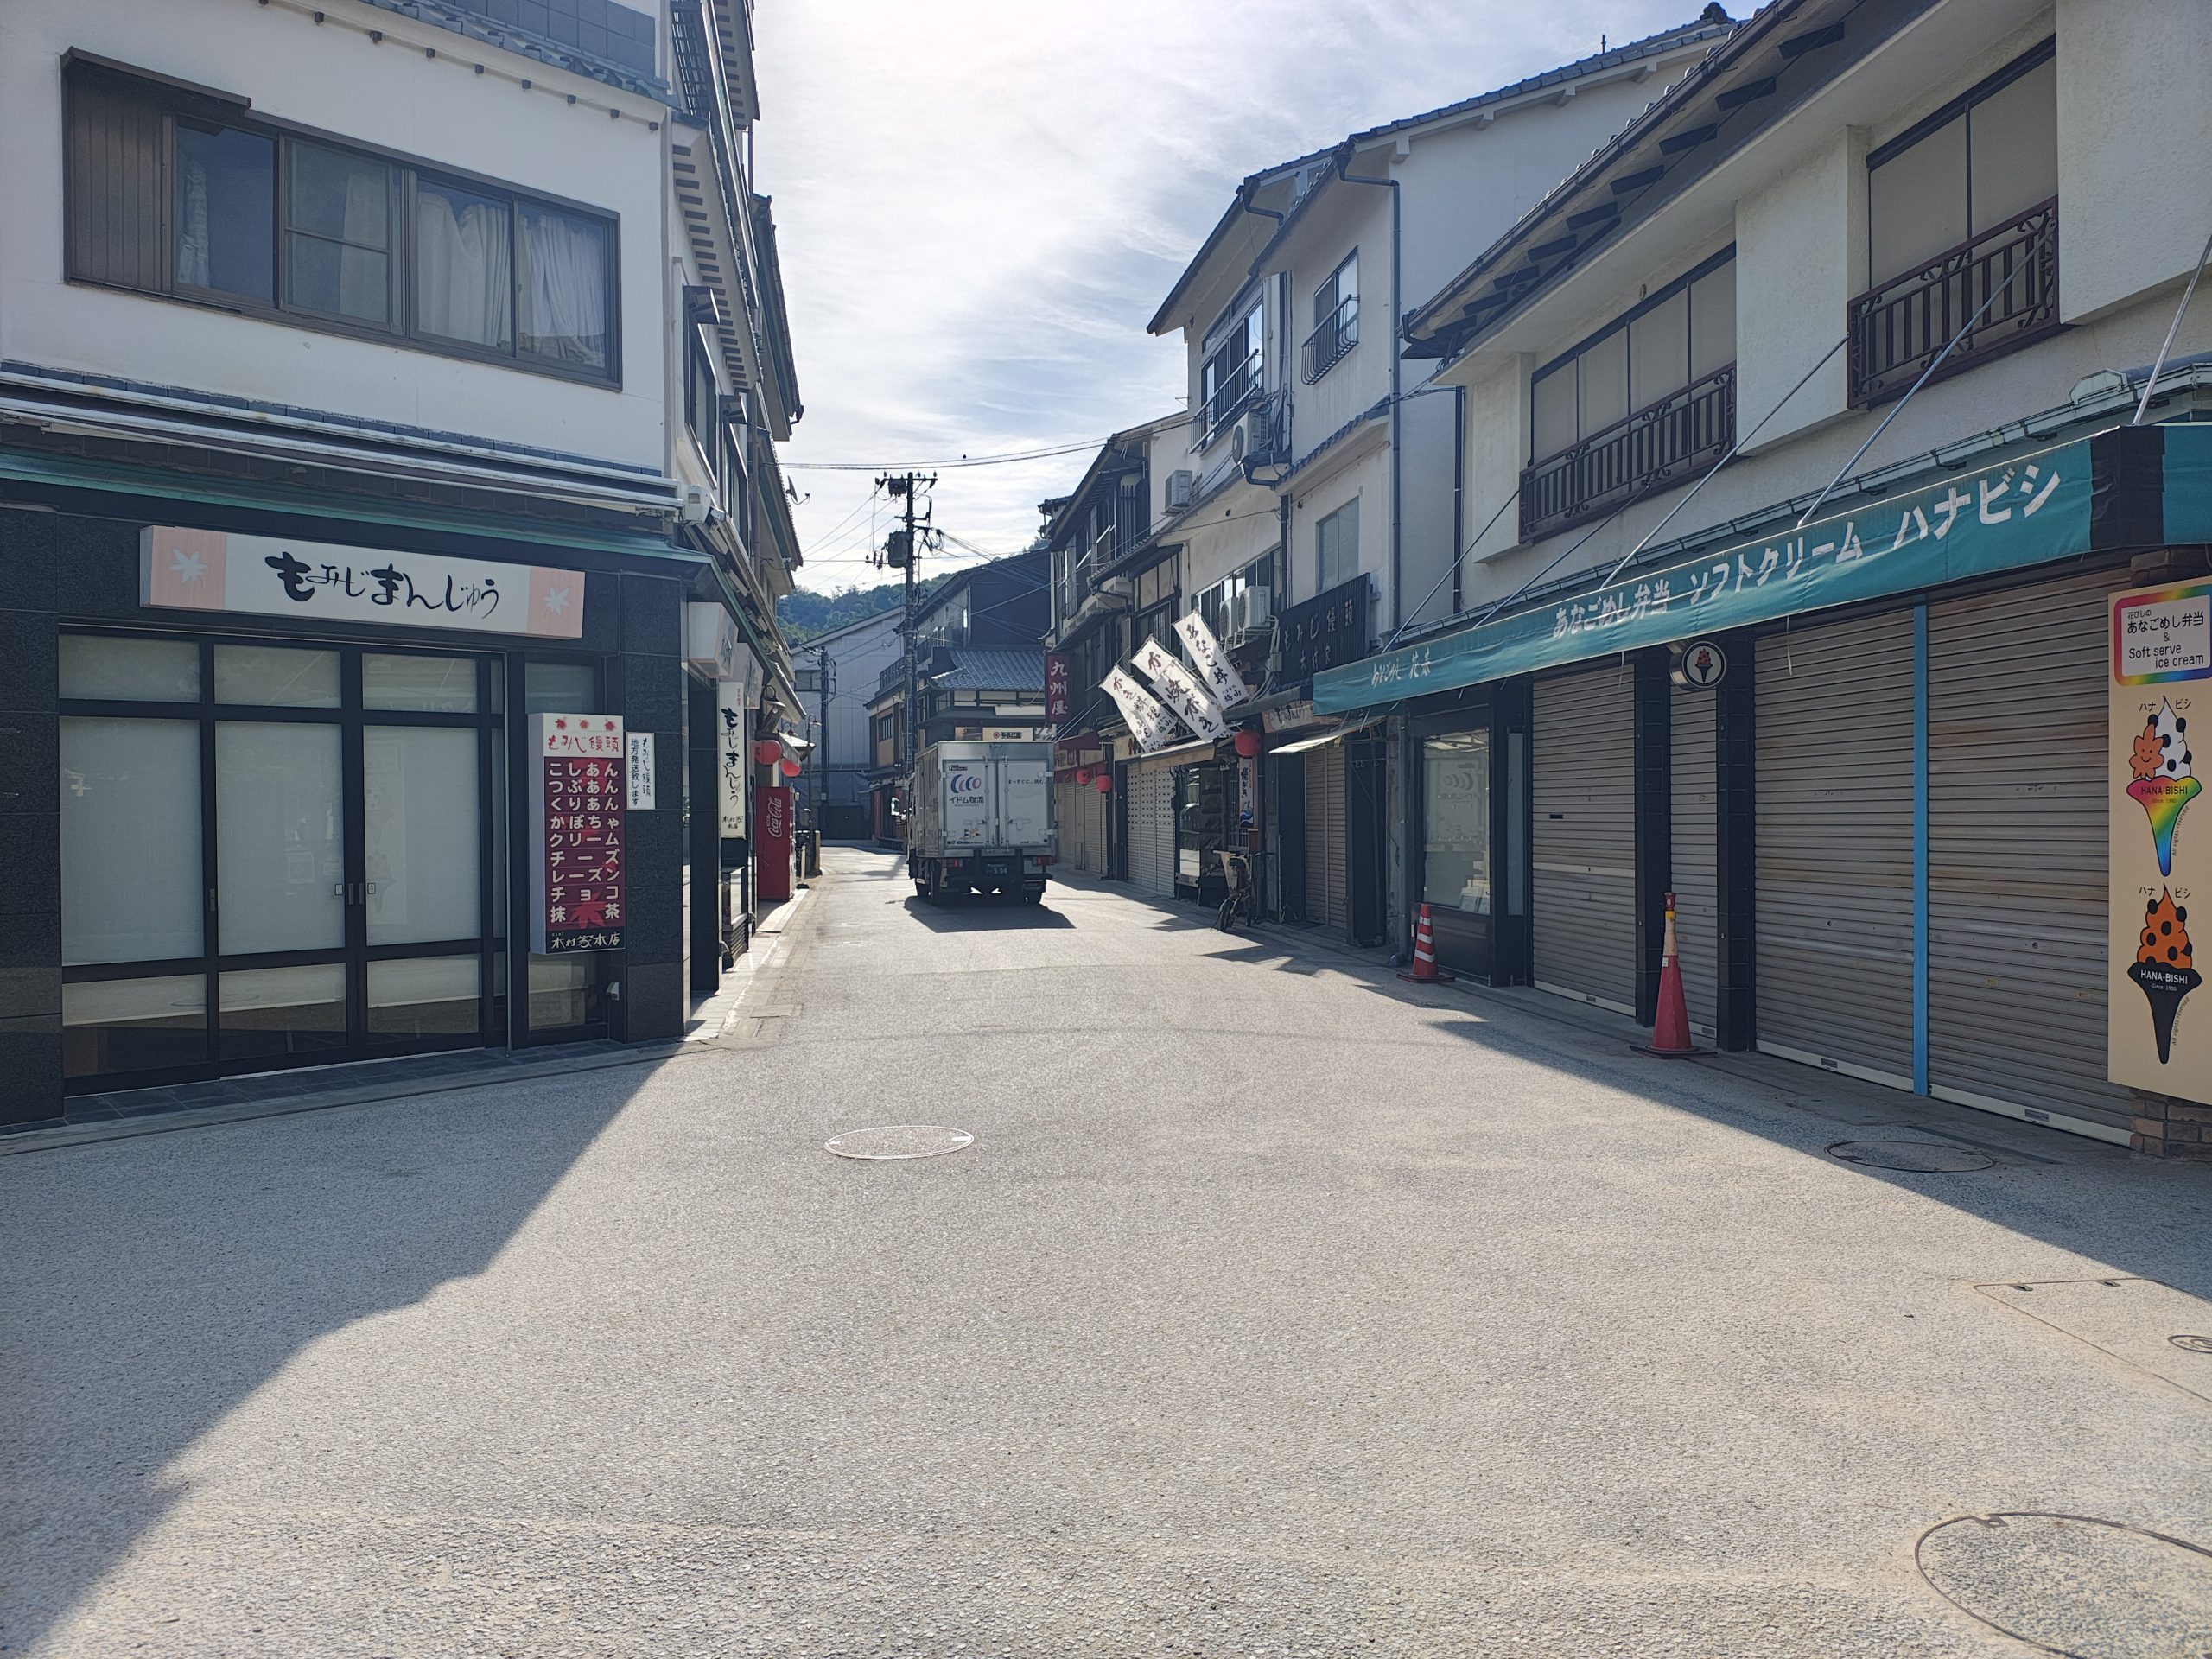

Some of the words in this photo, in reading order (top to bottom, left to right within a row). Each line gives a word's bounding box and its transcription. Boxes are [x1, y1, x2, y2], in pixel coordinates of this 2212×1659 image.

[1893, 465, 2061, 550] ハナビシ
[265, 551, 499, 620] もみじまんじゅう
[1554, 578, 1670, 637] あなごめし弁当
[1689, 522, 1863, 605] ソフトクリーム
[2127, 610, 2152, 620] 花びしの
[2127, 611, 2203, 633] あなごめし弁当
[2163, 632, 2170, 641] &
[2129, 646, 2151, 659] Soft
[2154, 645, 2181, 656] serve
[2156, 658, 2169, 669] ice
[2172, 654, 2204, 667] cream
[1050, 661, 1068, 715] 九州屋
[2139, 701, 2156, 712] ハナ
[2176, 699, 2192, 709] ビシ
[548, 735, 620, 753] もみじ饅頭
[549, 762, 619, 777] こしあん
[631, 738, 639, 806] 地方発送致します
[549, 779, 619, 795] つぶあん
[2141, 785, 2188, 795] HANA-BISHI
[550, 797, 619, 812] くりあん
[550, 815, 620, 830] かぼちゃ
[767, 796, 783, 838] Coca-Cola
[550, 832, 620, 849] クリーム
[550, 849, 620, 868] チーズ
[551, 868, 620, 884] レーズン
[550, 885, 619, 903] チョコ
[2139, 886, 2155, 896] ハナ
[2175, 887, 2191, 899] ビシ
[550, 903, 620, 924] 抹茶
[551, 931, 620, 950] 木村家本店
[2140, 969, 2188, 985] HANA-BISHI
